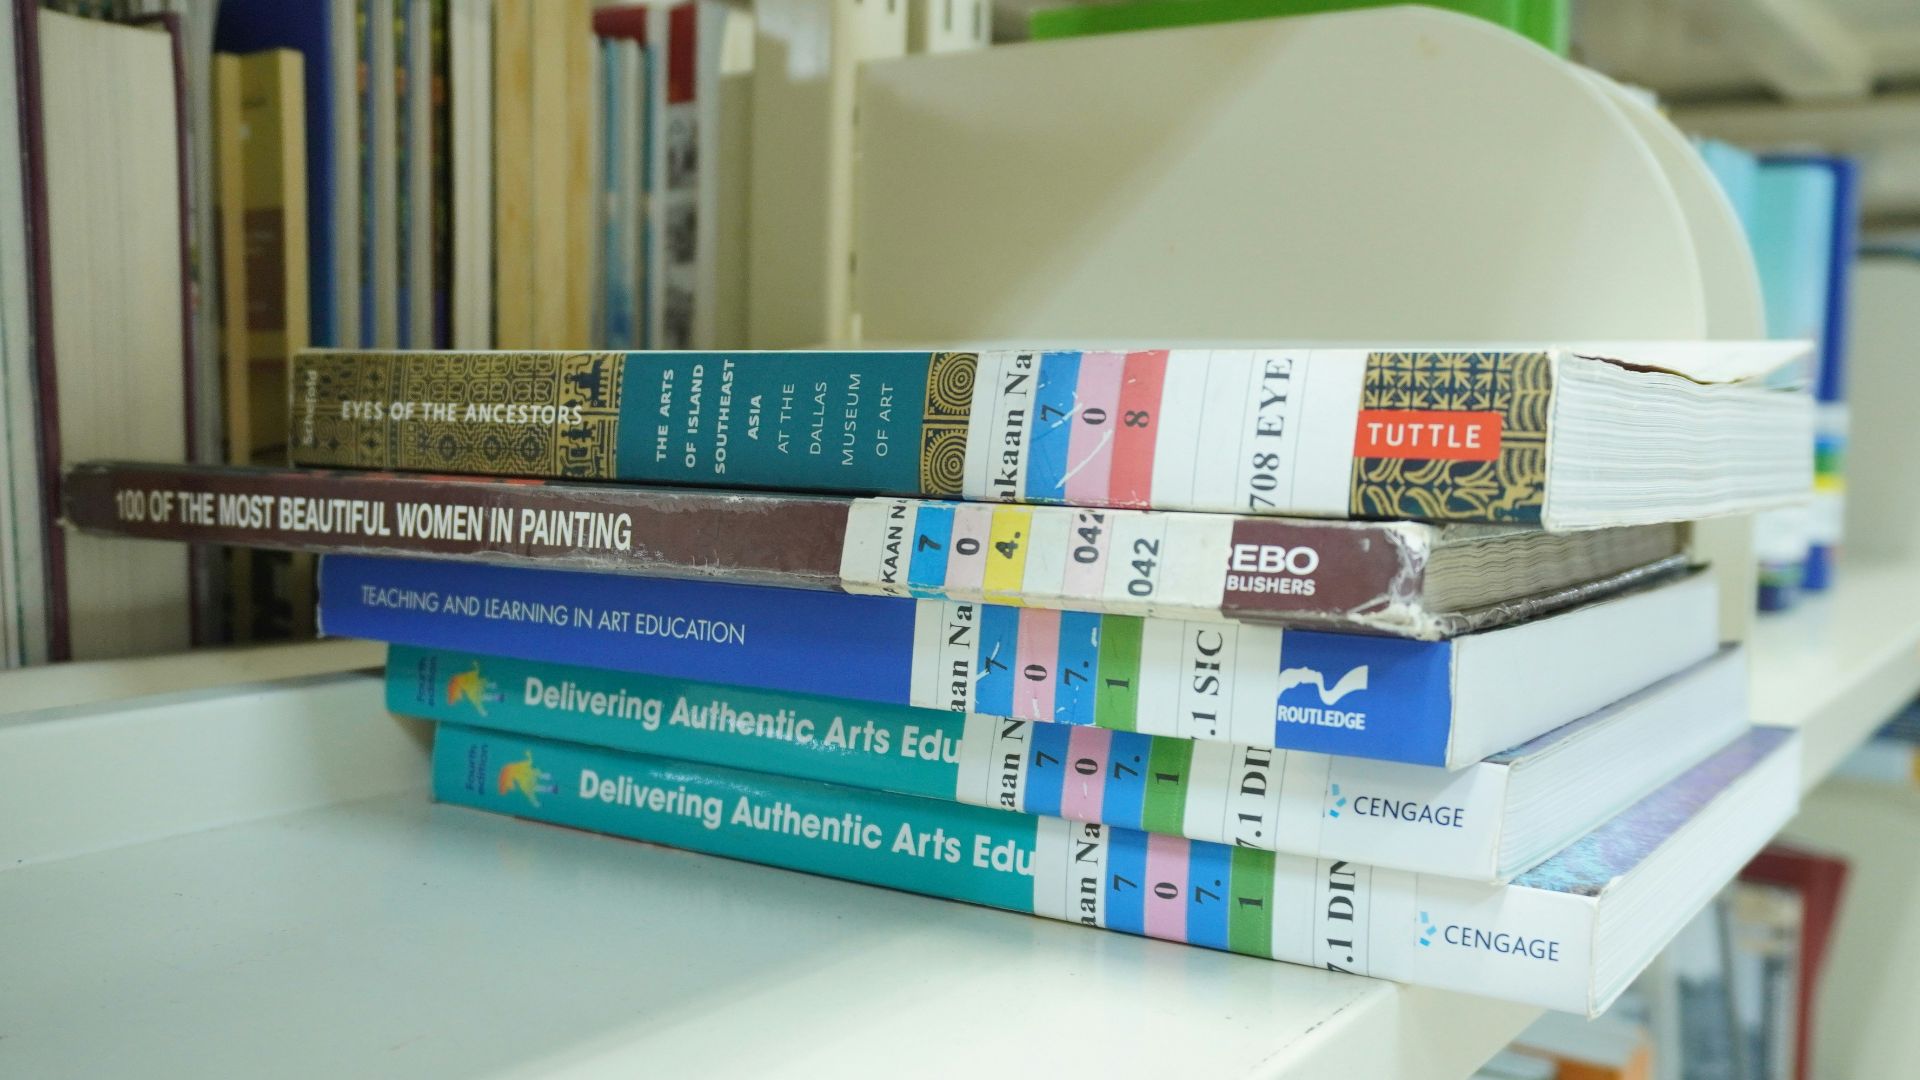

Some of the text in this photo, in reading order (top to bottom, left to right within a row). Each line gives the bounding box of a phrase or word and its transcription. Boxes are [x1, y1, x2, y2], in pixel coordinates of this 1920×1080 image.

[1004, 354, 1032, 398] Na
[341, 401, 583, 425] EYES OF THE ANCESTORS
[656, 369, 674, 462] THE ARTS
[685, 364, 704, 468] OF ISLAND
[715, 359, 735, 474] SOUTHEAST
[748, 394, 762, 440] ASIA
[777, 383, 795, 454] AT THE
[810, 381, 827, 455] DALLAS
[842, 373, 861, 466] MUSEUM
[876, 383, 894, 457] OF ART
[1040, 404, 1066, 422] 7
[1083, 407, 1107, 425] 0
[1124, 410, 1150, 428] 8
[1250, 357, 1293, 512] 708 EYE
[1367, 423, 1481, 449] TUTTLE
[116, 489, 632, 550] 100 OF THE MOST BEAUTIFUL WOMEN IN PAINTING
[918, 534, 942, 553] 7
[956, 537, 980, 556] 0
[996, 531, 1021, 560] 4.
[1127, 538, 1159, 597] 042
[1227, 543, 1319, 575] EBO
[361, 585, 745, 645] TEACHING AND LEARNING IN ART EDUCATION
[948, 603, 973, 649] Na
[985, 656, 1009, 674] 7
[1024, 664, 1047, 681] 0
[1064, 660, 1089, 686] 7.
[1193, 630, 1223, 696] SIC
[1105, 677, 1130, 690] 1
[524, 677, 962, 764] Delivering Authentic Arts Edu
[1277, 705, 1365, 730] ROUTLEDGE
[1036, 750, 1059, 768] 7
[1075, 758, 1098, 776] 0
[1113, 755, 1140, 780] 7.
[1155, 772, 1180, 785] 1
[579, 769, 1037, 877] Delivering Authentic Arts Edu
[1354, 796, 1465, 828] CENGAGE
[1075, 823, 1102, 867] Na
[1113, 874, 1137, 892] 7
[1154, 882, 1179, 900] 0
[1195, 879, 1221, 905] 7.
[1238, 896, 1264, 911] 1
[1445, 925, 1559, 962] CENGAGE
